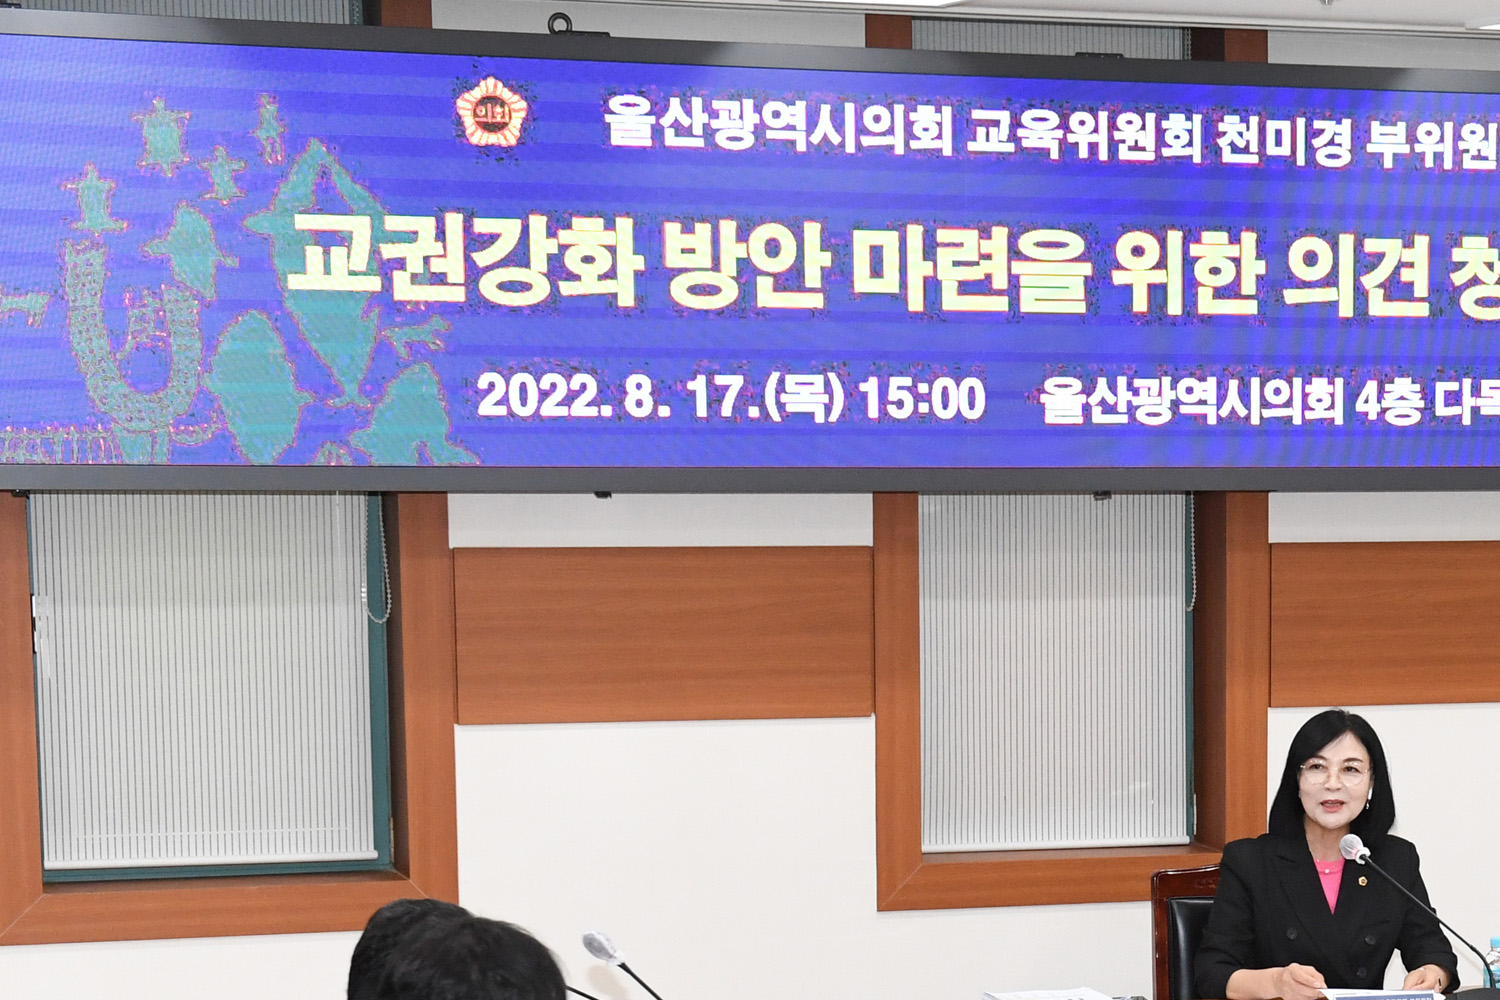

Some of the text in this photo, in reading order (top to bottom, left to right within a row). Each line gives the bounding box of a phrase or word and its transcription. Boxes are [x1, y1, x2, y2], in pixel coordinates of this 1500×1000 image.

[474, 103, 510, 123] 의회
[604, 94, 953, 157] 울산광역시의회
[966, 108, 1203, 164] 교육위원회
[1216, 115, 1352, 168] 천미경
[286, 212, 645, 307] 교권강화
[664, 219, 832, 310] 방안
[852, 224, 1093, 314] 마련을
[1111, 230, 1266, 316] 위한
[1282, 233, 1430, 318] 의견
[858, 376, 986, 420] 15:00
[1039, 375, 1344, 426] 울산광역시의회
[1355, 376, 1425, 427] 4층
